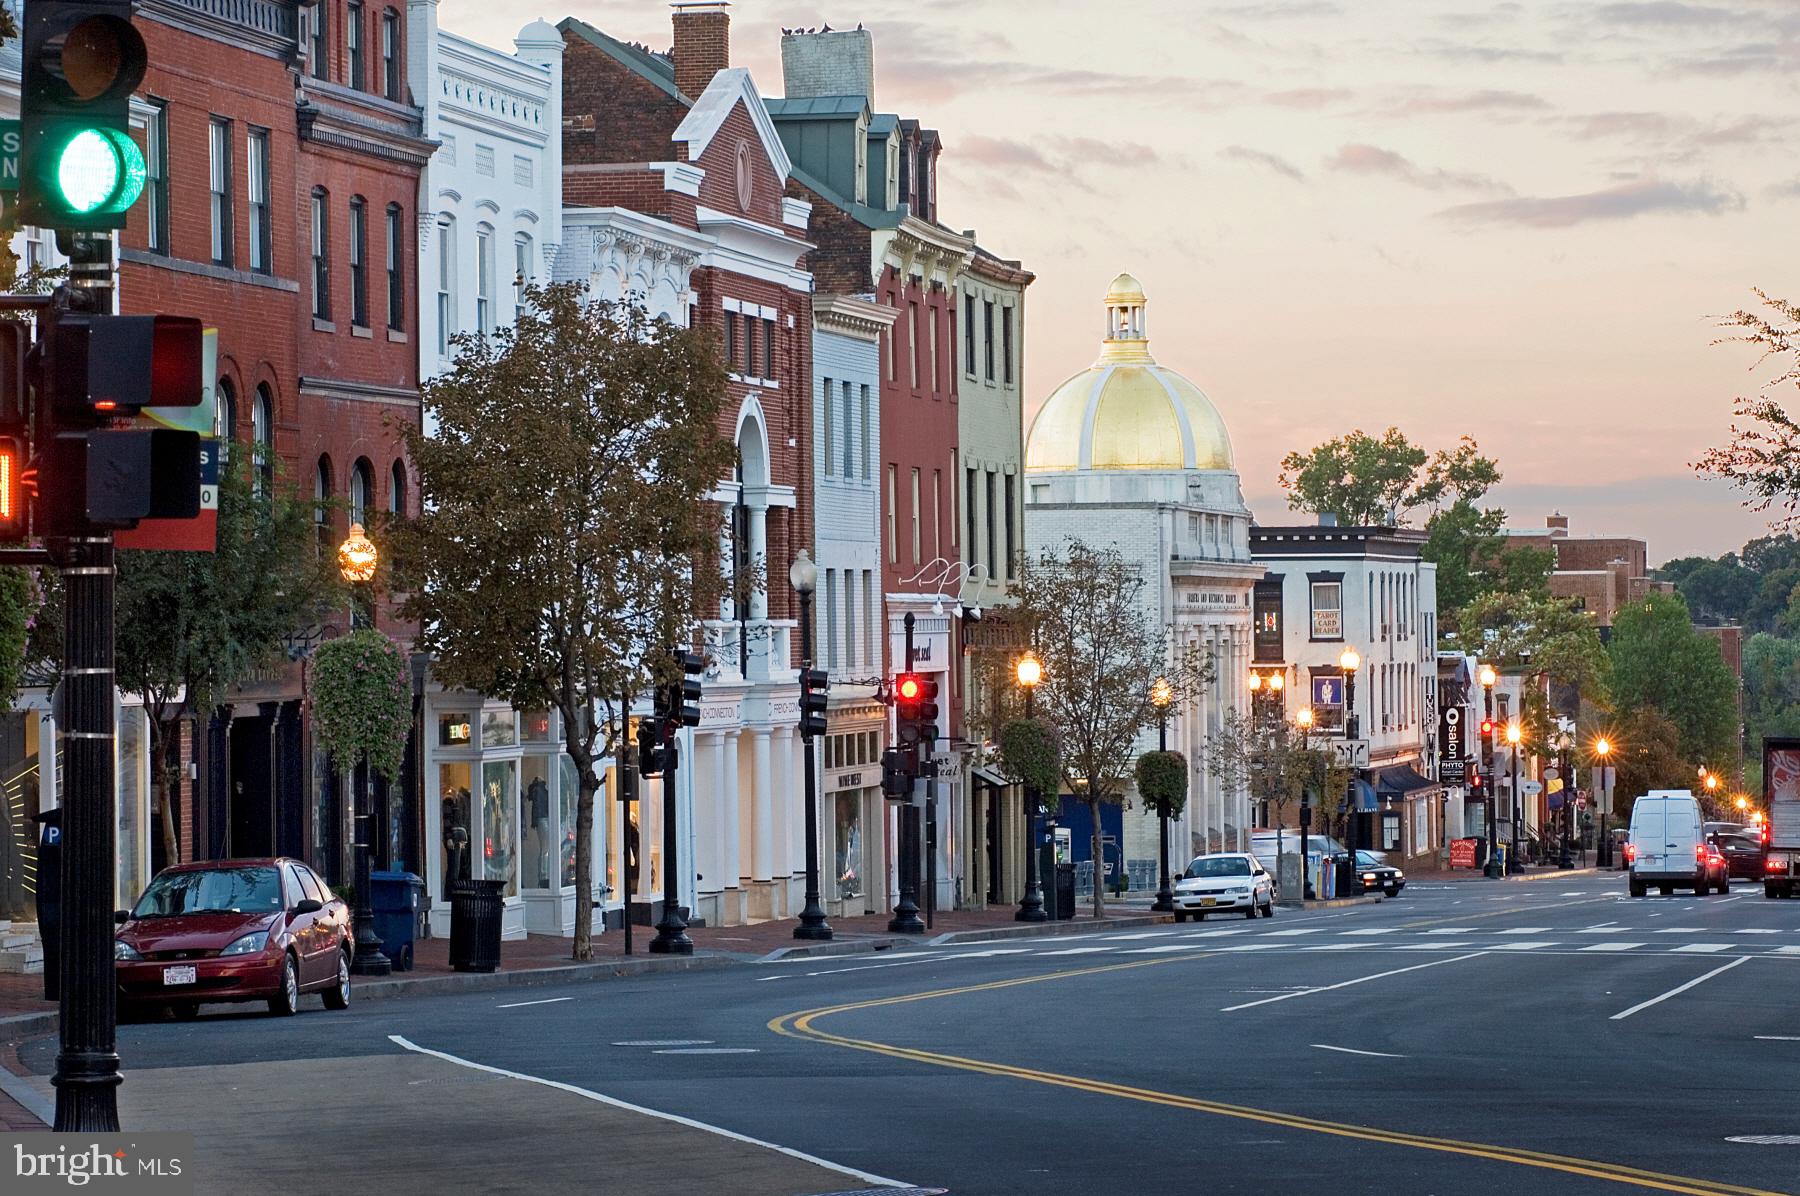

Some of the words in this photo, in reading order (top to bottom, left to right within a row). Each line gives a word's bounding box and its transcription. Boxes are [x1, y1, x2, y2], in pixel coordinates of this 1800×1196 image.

[921, 638, 932, 662] seal
[838, 774, 850, 788] NINE
[850, 773, 862, 786] WEST
[49, 827, 60, 843] P
[1045, 834, 1052, 843] P
